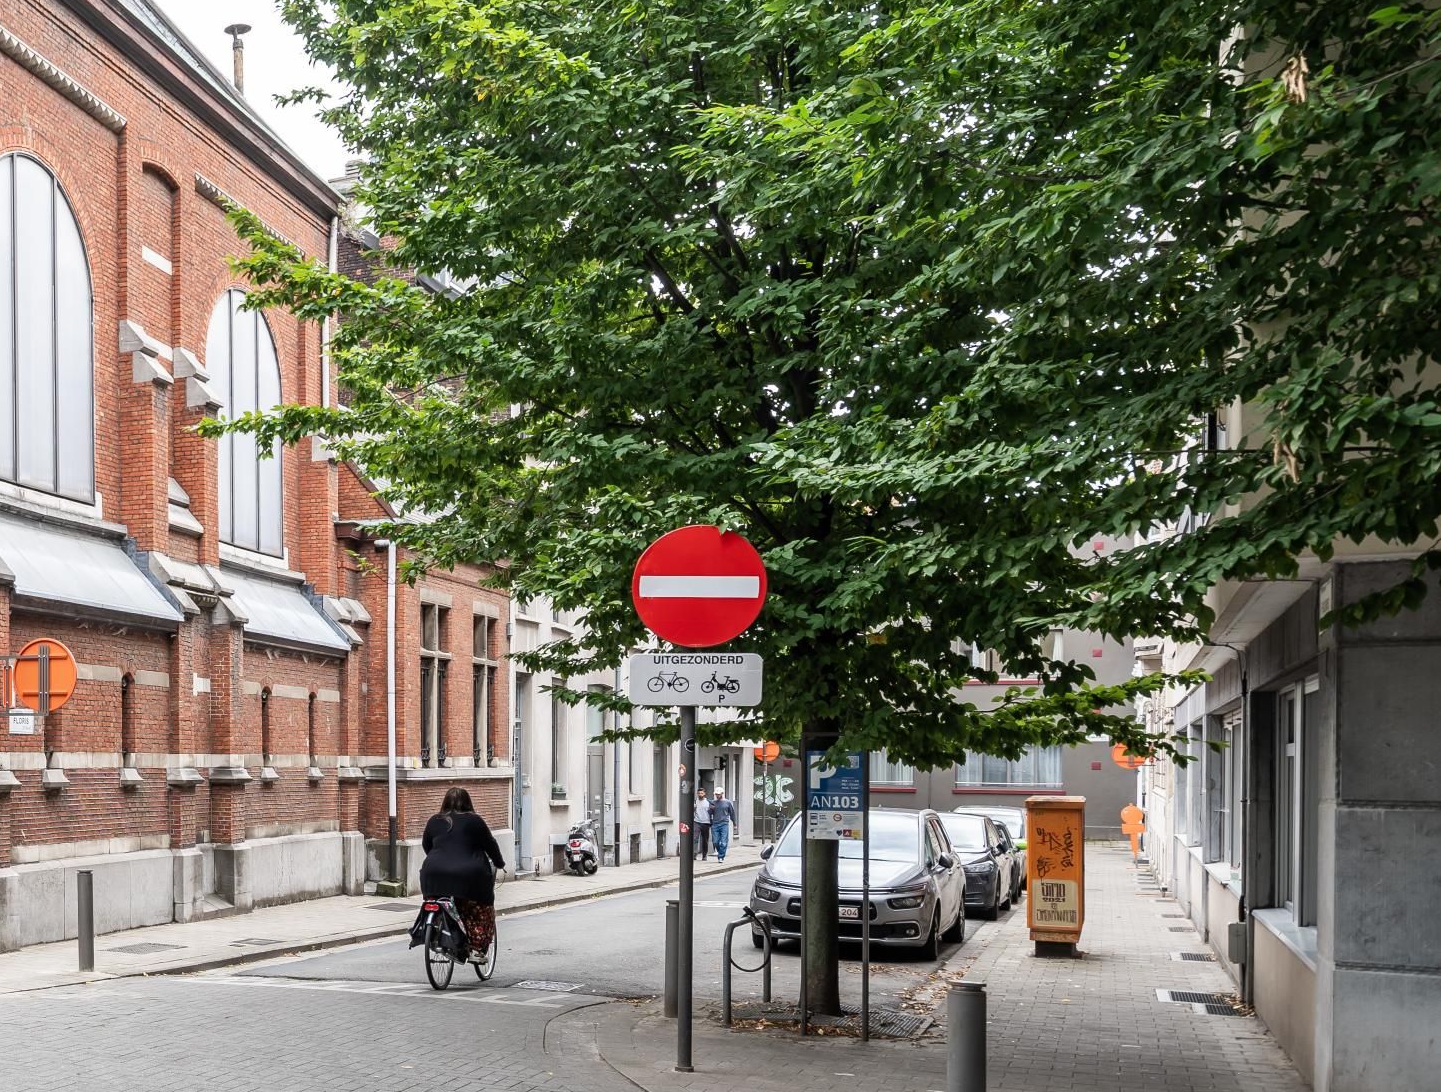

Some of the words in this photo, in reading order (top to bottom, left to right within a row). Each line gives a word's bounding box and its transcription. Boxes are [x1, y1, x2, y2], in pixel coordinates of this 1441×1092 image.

[653, 655, 744, 665] UITGEZONDERD
[718, 694, 726, 703] P
[810, 755, 837, 789] P
[810, 795, 859, 808] AN103
[841, 908, 858, 917] 204
